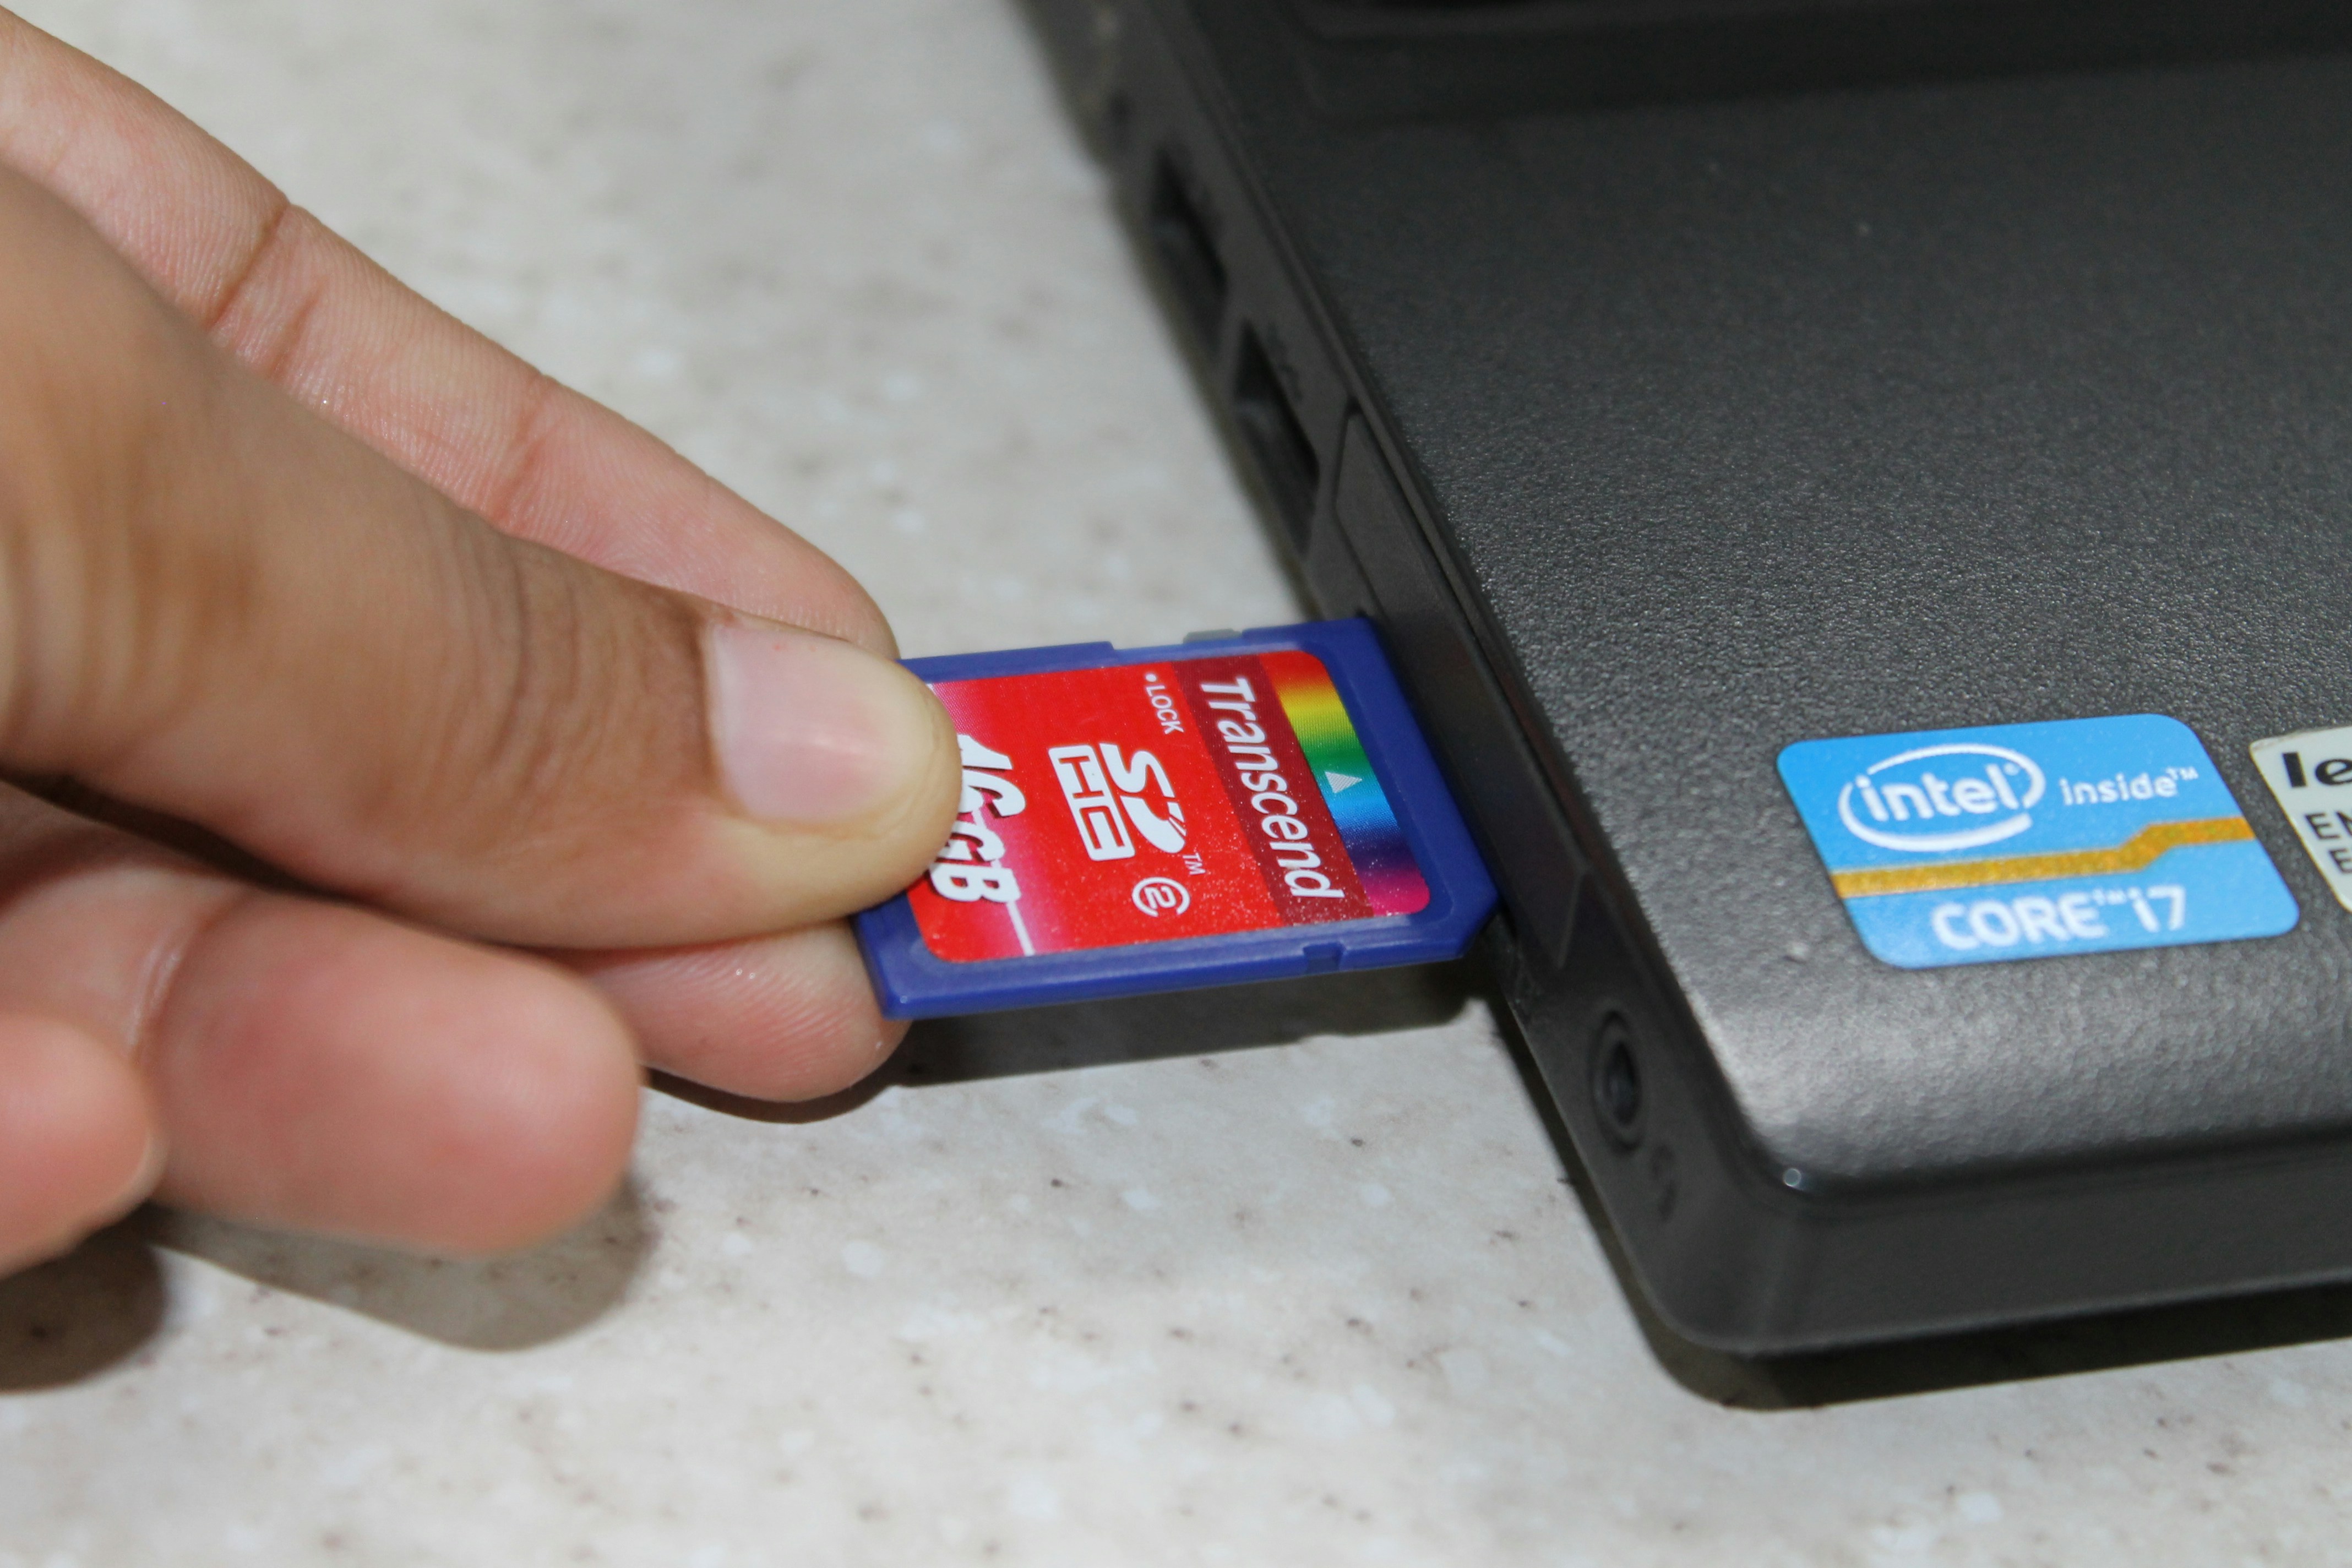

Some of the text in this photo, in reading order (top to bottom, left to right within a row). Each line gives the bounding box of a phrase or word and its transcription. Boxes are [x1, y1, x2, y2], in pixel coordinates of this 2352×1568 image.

[1145, 684, 1184, 734] LOCK
[1058, 755, 1126, 850] HC
[1200, 677, 1345, 898] Transcend
[2127, 884, 2186, 933] i7
